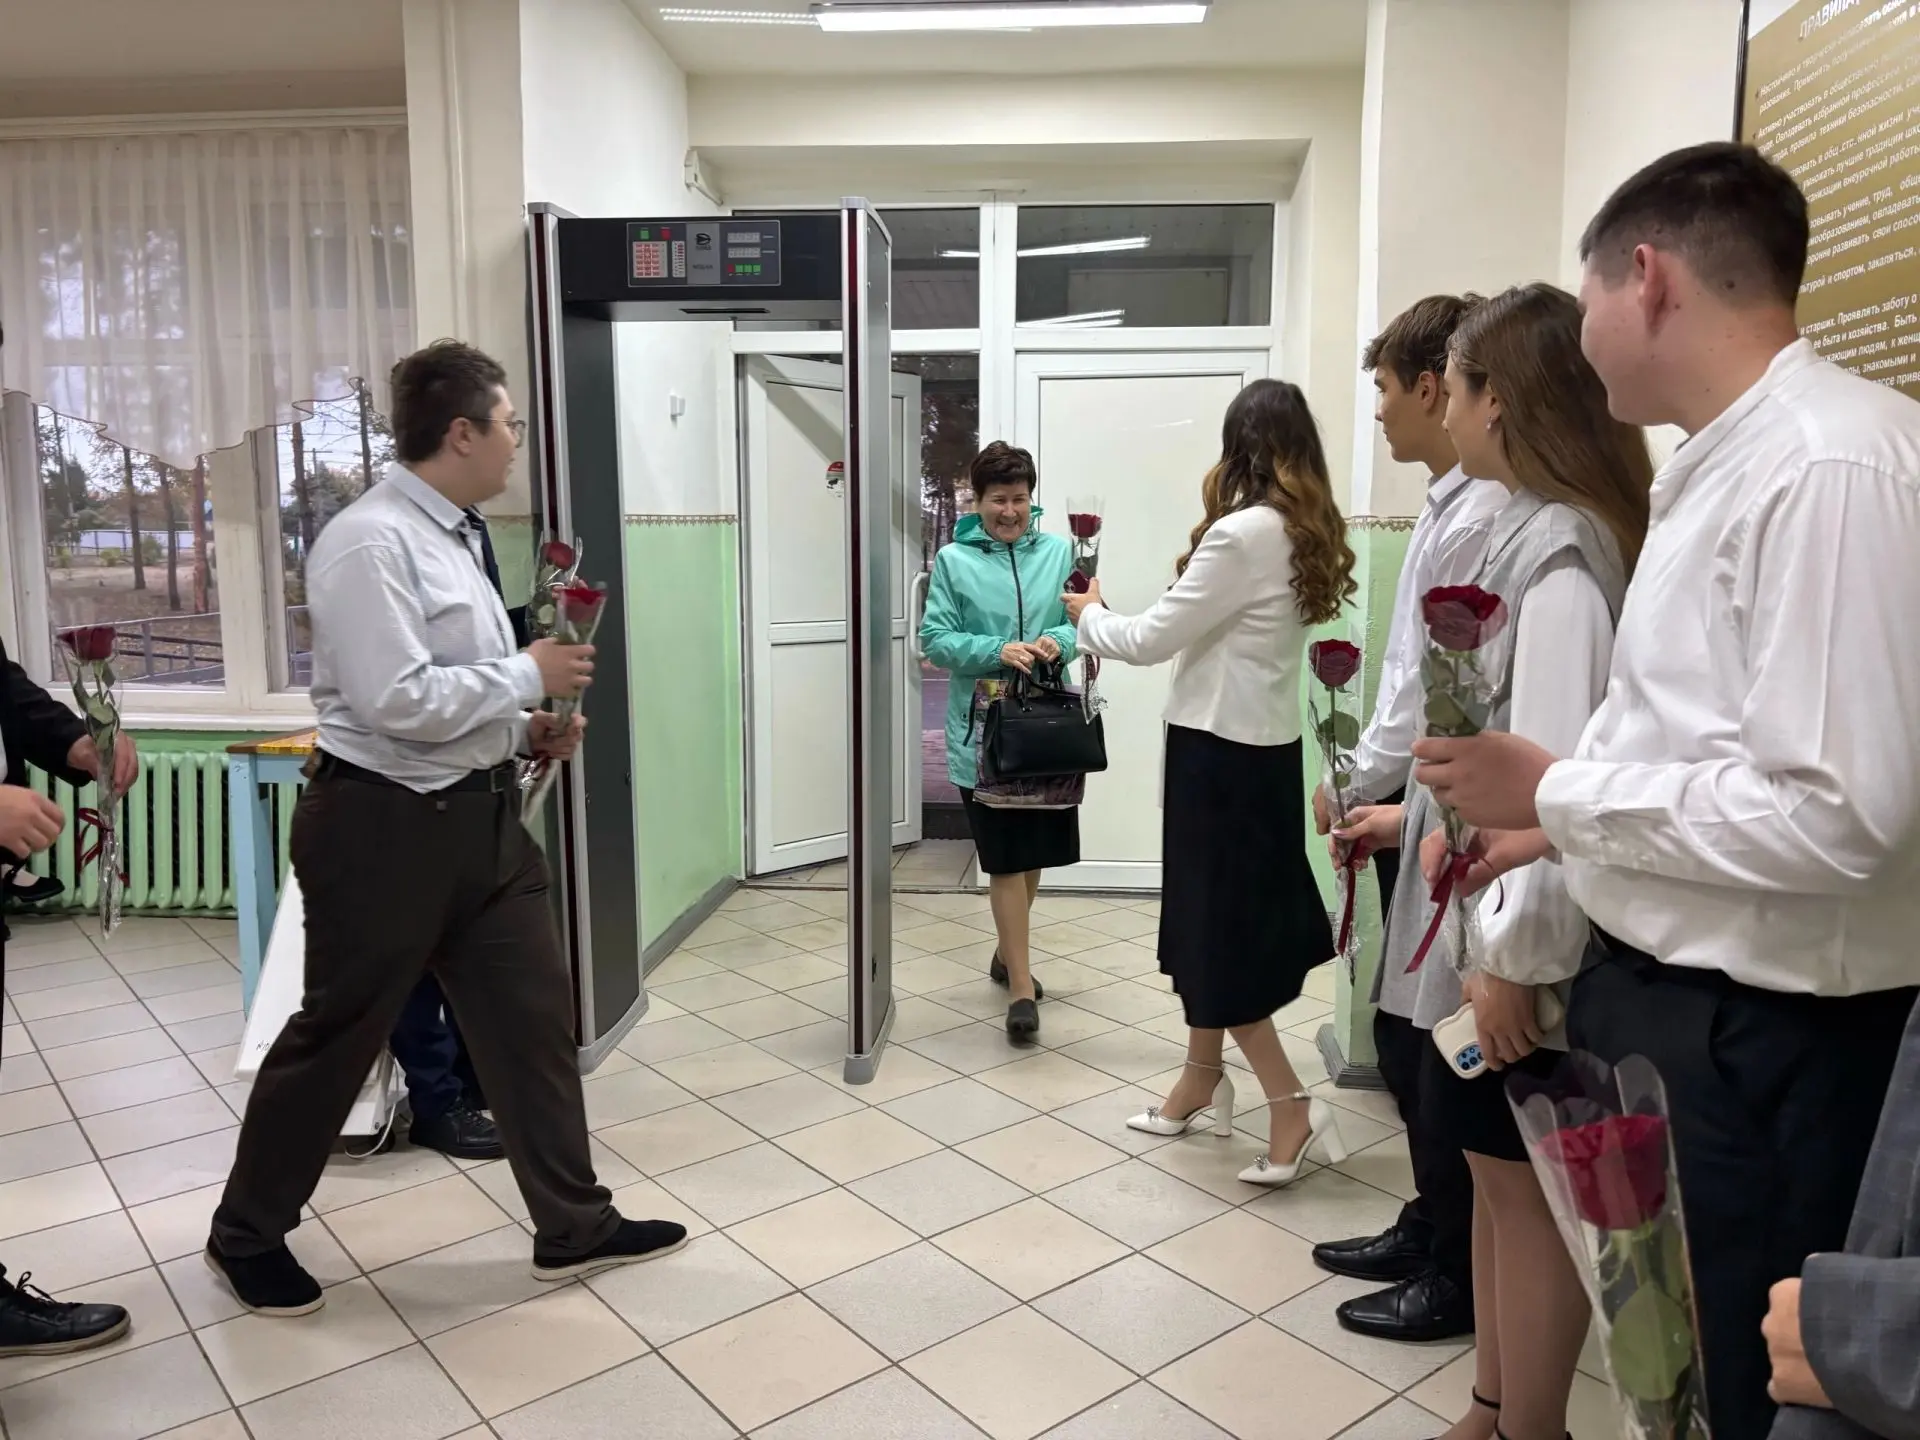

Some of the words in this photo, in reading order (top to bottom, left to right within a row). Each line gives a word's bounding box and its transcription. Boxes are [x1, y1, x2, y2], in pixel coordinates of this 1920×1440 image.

[1824, 123, 1878, 160] общствнной
[1832, 232, 1870, 258] развивать
[1872, 224, 1891, 240] свои
[1893, 212, 1920, 232] спосо
[1838, 303, 1880, 326] Проявлять
[1881, 294, 1910, 313] заботу
[1911, 293, 1918, 304] о
[1894, 313, 1917, 329] Быть
[1862, 354, 1908, 373] знакомыми
[1910, 352, 1917, 363] и
